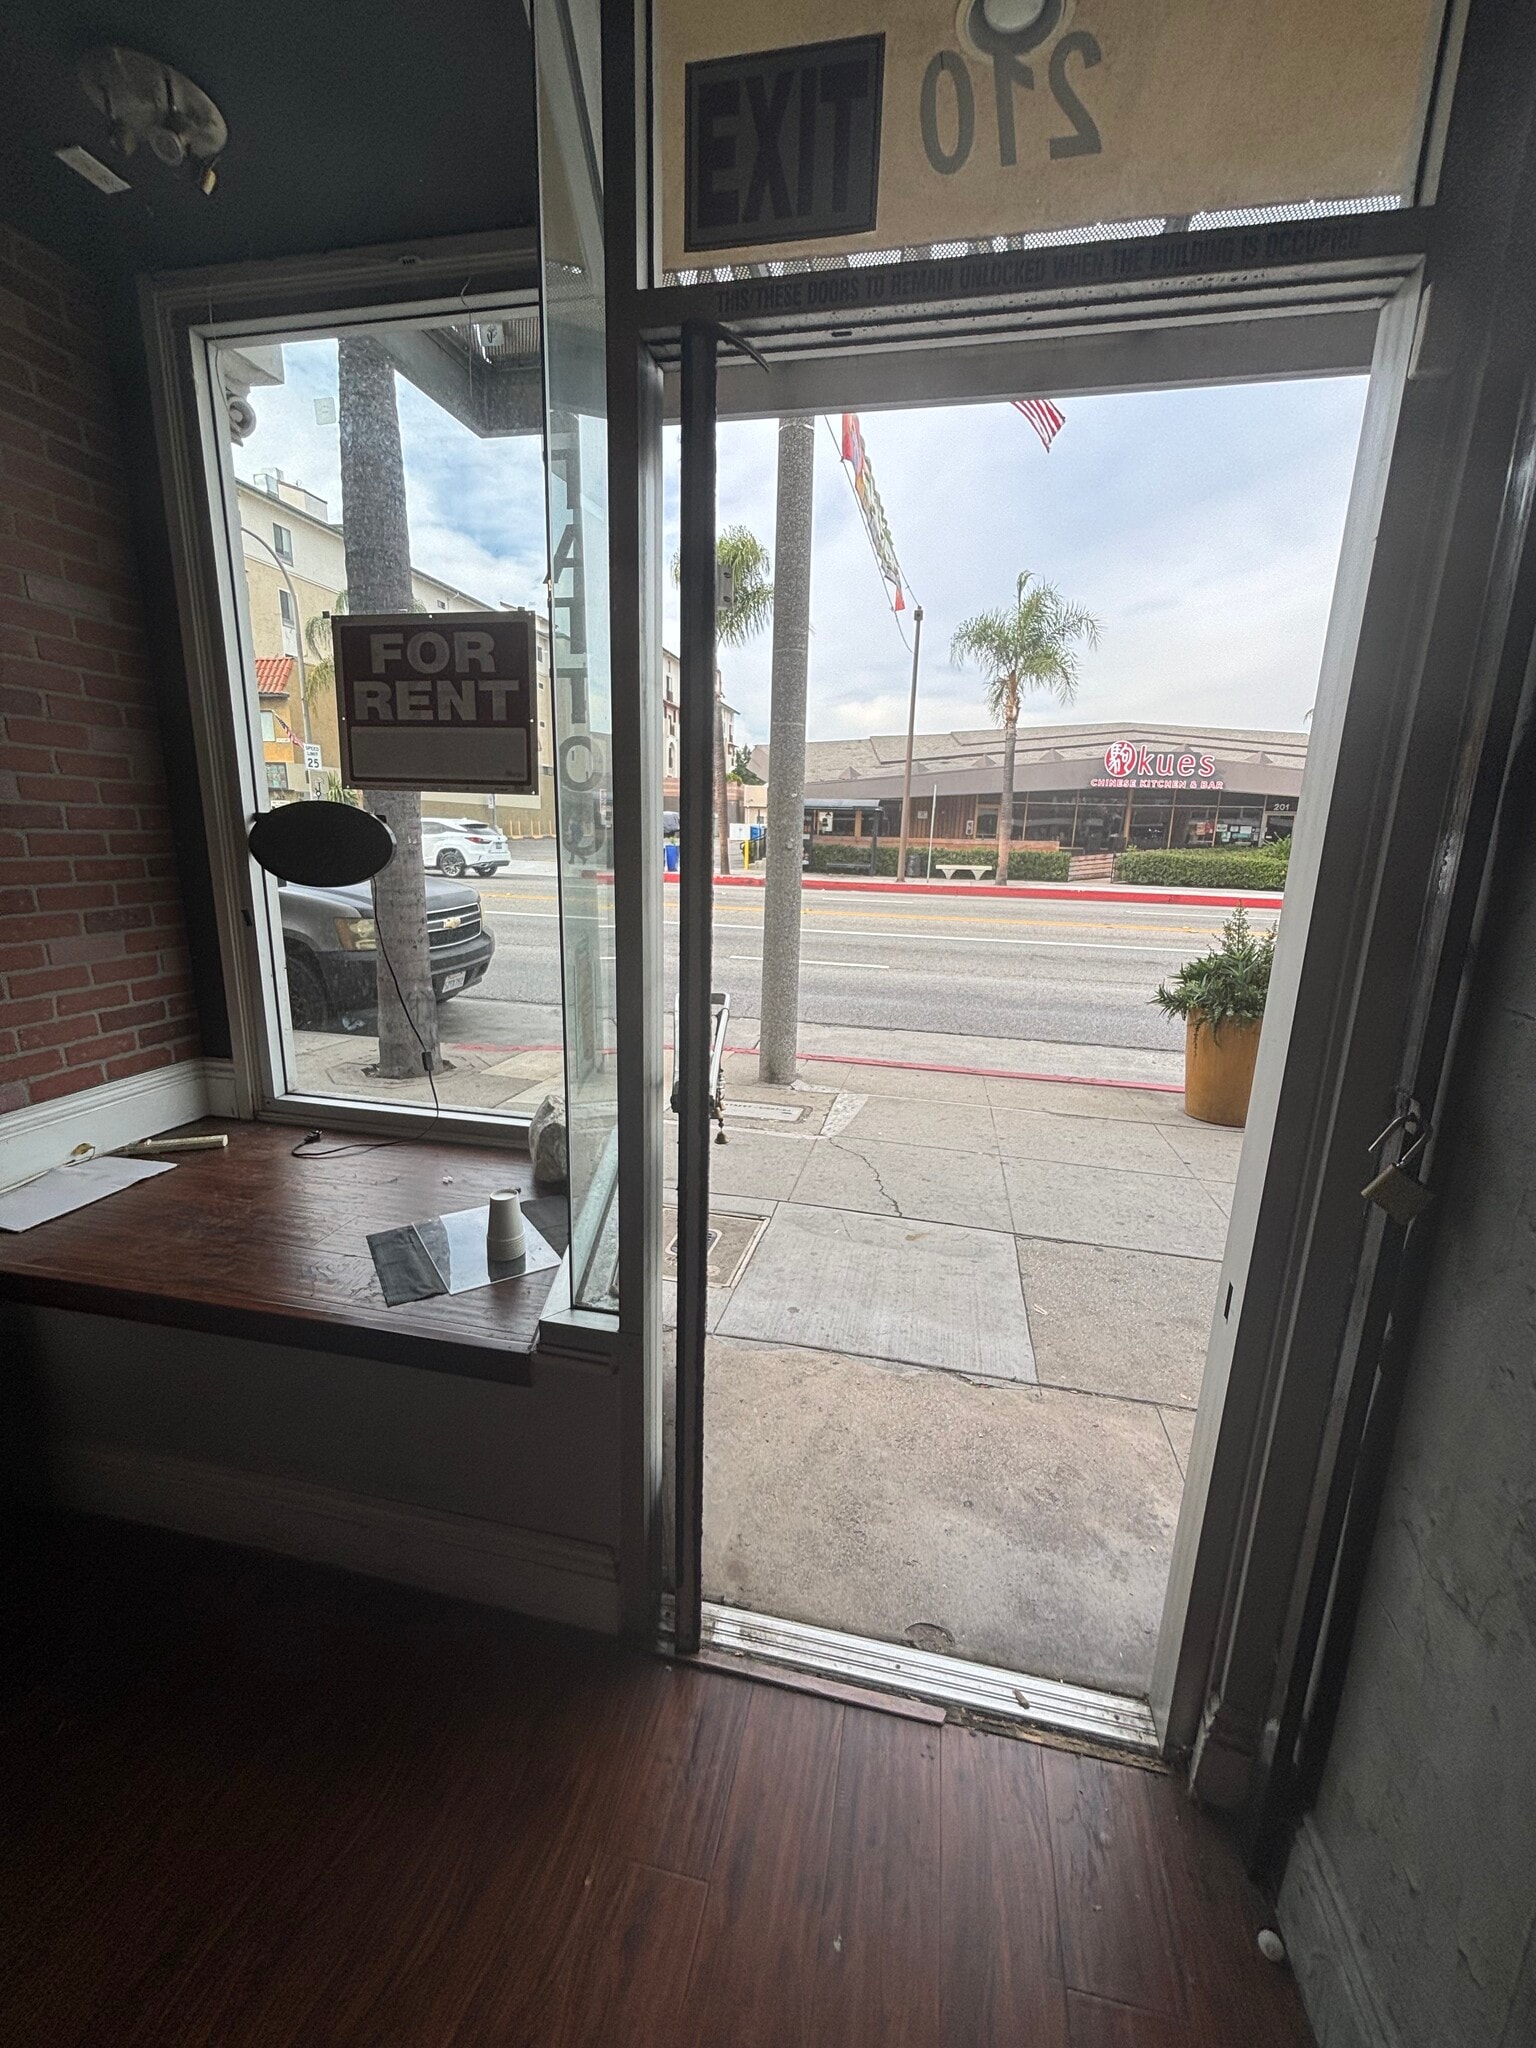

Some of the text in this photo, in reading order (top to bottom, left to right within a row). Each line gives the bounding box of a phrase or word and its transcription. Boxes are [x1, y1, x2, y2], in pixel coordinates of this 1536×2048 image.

[698, 59, 869, 230] EXIT
[808, 278, 858, 305] DOORS
[866, 275, 884, 299] TO
[892, 269, 951, 297] REMAIN
[960, 261, 1045, 290] UNLOCKED
[1053, 251, 1105, 280] WHEN
[1112, 246, 1144, 275] THE
[1151, 238, 1234, 269] BUILDING
[1242, 235, 1258, 261] IS
[1266, 224, 1363, 259] OCCUPIED
[369, 631, 496, 674] FOR
[353, 680, 519, 721] RENT
[307, 757, 320, 768] 25
[1137, 745, 1216, 777] kues
[1090, 778, 1224, 790] CHINESE KITCHEN & BAR
[1273, 803, 1290, 811] 201
